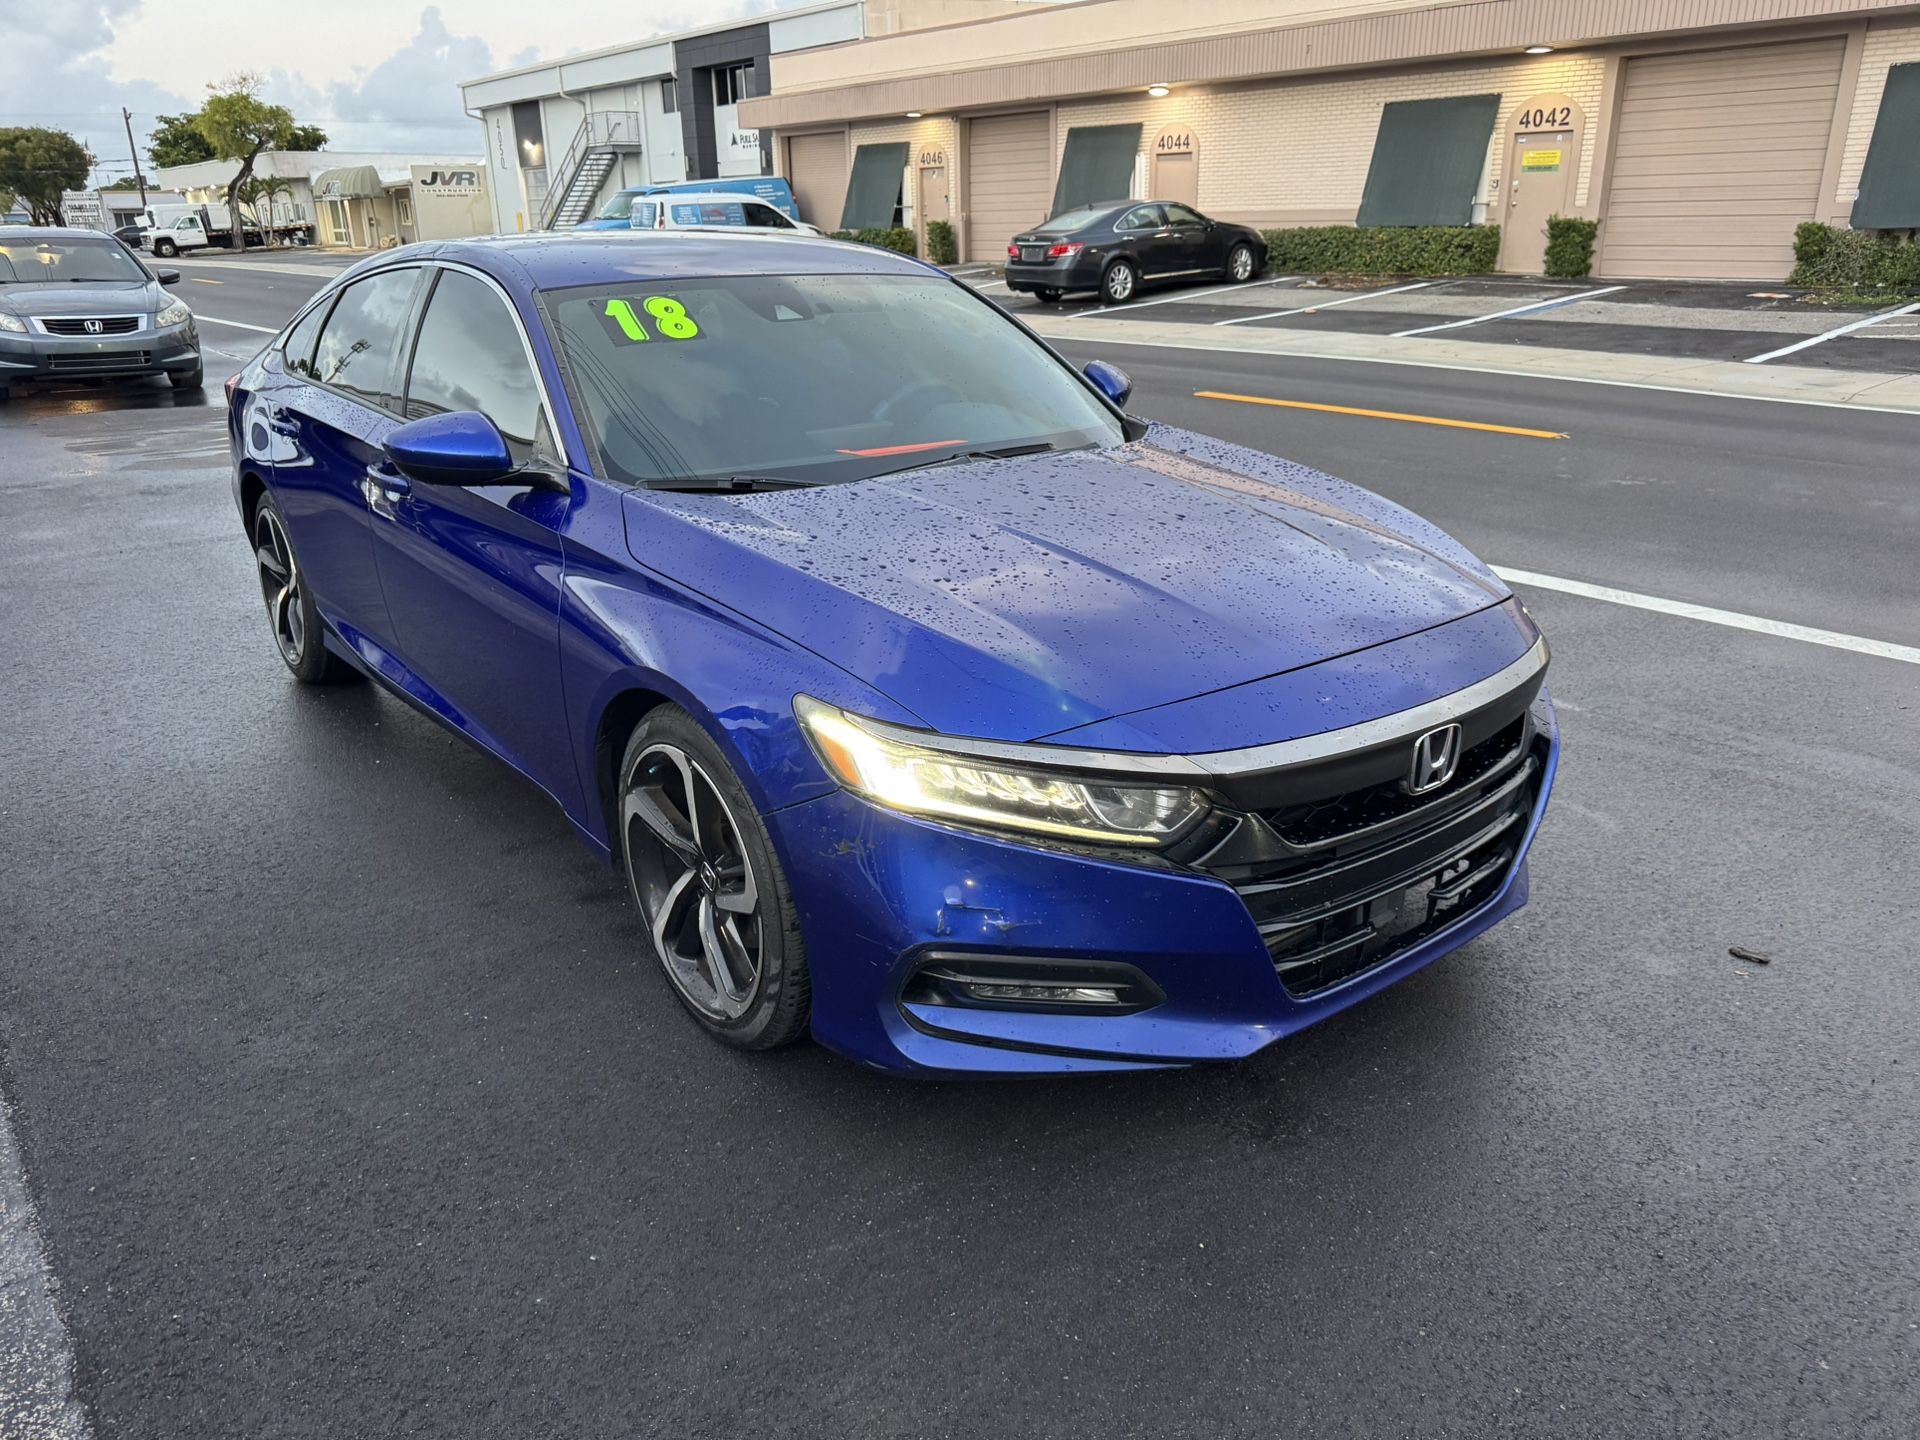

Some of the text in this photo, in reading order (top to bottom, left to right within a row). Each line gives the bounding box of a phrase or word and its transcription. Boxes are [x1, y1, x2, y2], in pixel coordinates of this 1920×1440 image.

[1519, 106, 1571, 129] 4042
[1158, 133, 1190, 151] 4044
[920, 151, 943, 165] 4046
[420, 171, 476, 186] JVR
[604, 296, 699, 341] 18
